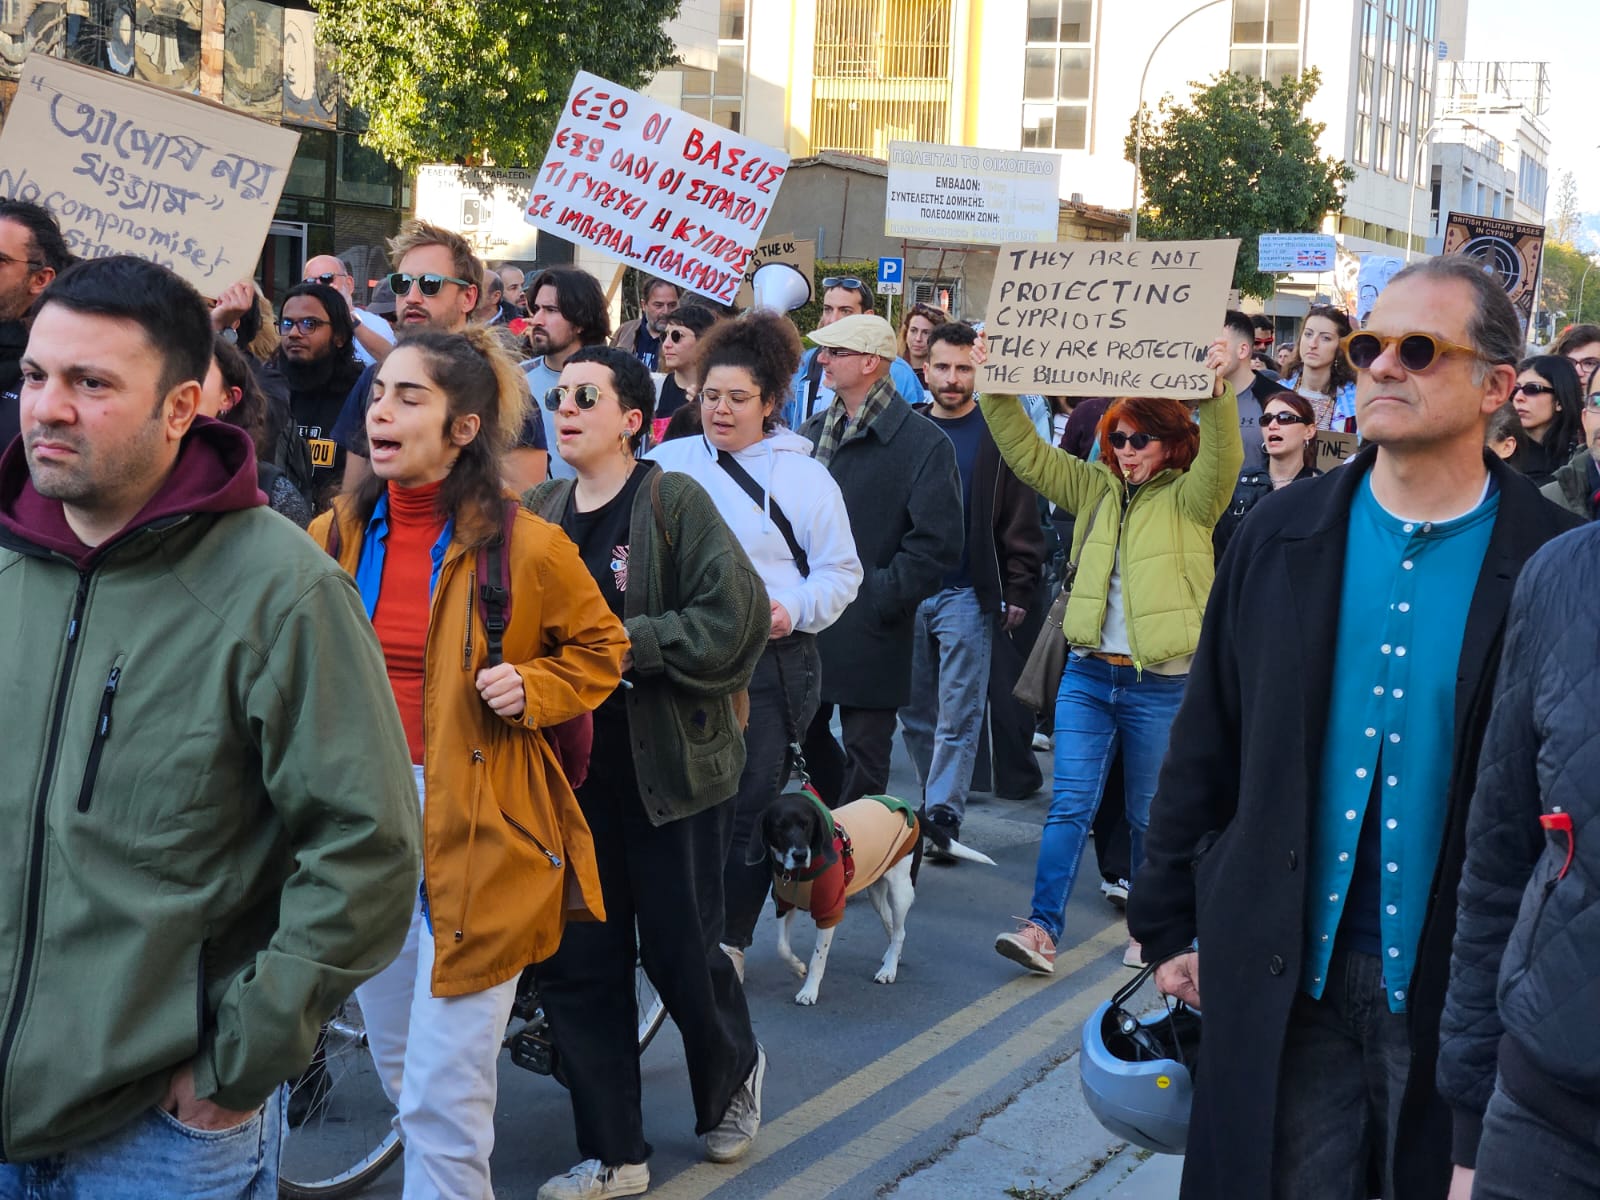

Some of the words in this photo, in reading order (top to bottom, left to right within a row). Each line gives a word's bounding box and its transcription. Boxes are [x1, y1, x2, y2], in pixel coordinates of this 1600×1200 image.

[642, 112, 672, 145] ΟΙ
[682, 127, 785, 194] ΒΑΣΕΙΣ
[960, 155, 980, 170] ΤΟ
[609, 147, 659, 185] ΟΛΟΙ
[658, 167, 687, 195] ΟΙ
[685, 178, 769, 231] ΣΤΡΑΤΟΙ
[935, 176, 981, 191] ΕΜΒΑΔΟΝ:
[527, 194, 556, 219] ΣΕ
[891, 191, 944, 205] ΣΥΝΤΕΛΕΣΤΗΣ
[946, 195, 985, 208] ΔΟΜΗΣΗΣ:
[545, 161, 568, 187] ΤΙ
[566, 171, 648, 220] ΓΥΡΕΥΕΙ
[649, 207, 673, 232] Η
[670, 216, 753, 275] ΚΥΠΡΟΣ
[977, 212, 1000, 223] ΖΩΝΗ:
[1452, 215, 1481, 227] BRITISH
[1482, 220, 1515, 232] MILITARY
[1516, 226, 1540, 235] BASES
[1485, 229, 1514, 239] CYPRUS
[760, 242, 781, 257] THE
[783, 242, 795, 253] US
[1010, 250, 1074, 271] THEY
[1089, 249, 1141, 267] ARE
[1151, 250, 1200, 267] NOT
[883, 261, 897, 280] P
[1000, 279, 1191, 305] PROTECTING
[996, 306, 1127, 330] CYPRIOTS
[1055, 340, 1098, 360] ARE
[1107, 339, 1213, 362] PROTECTIN
[984, 364, 1025, 383] THE
[1150, 373, 1209, 391] CLASS
